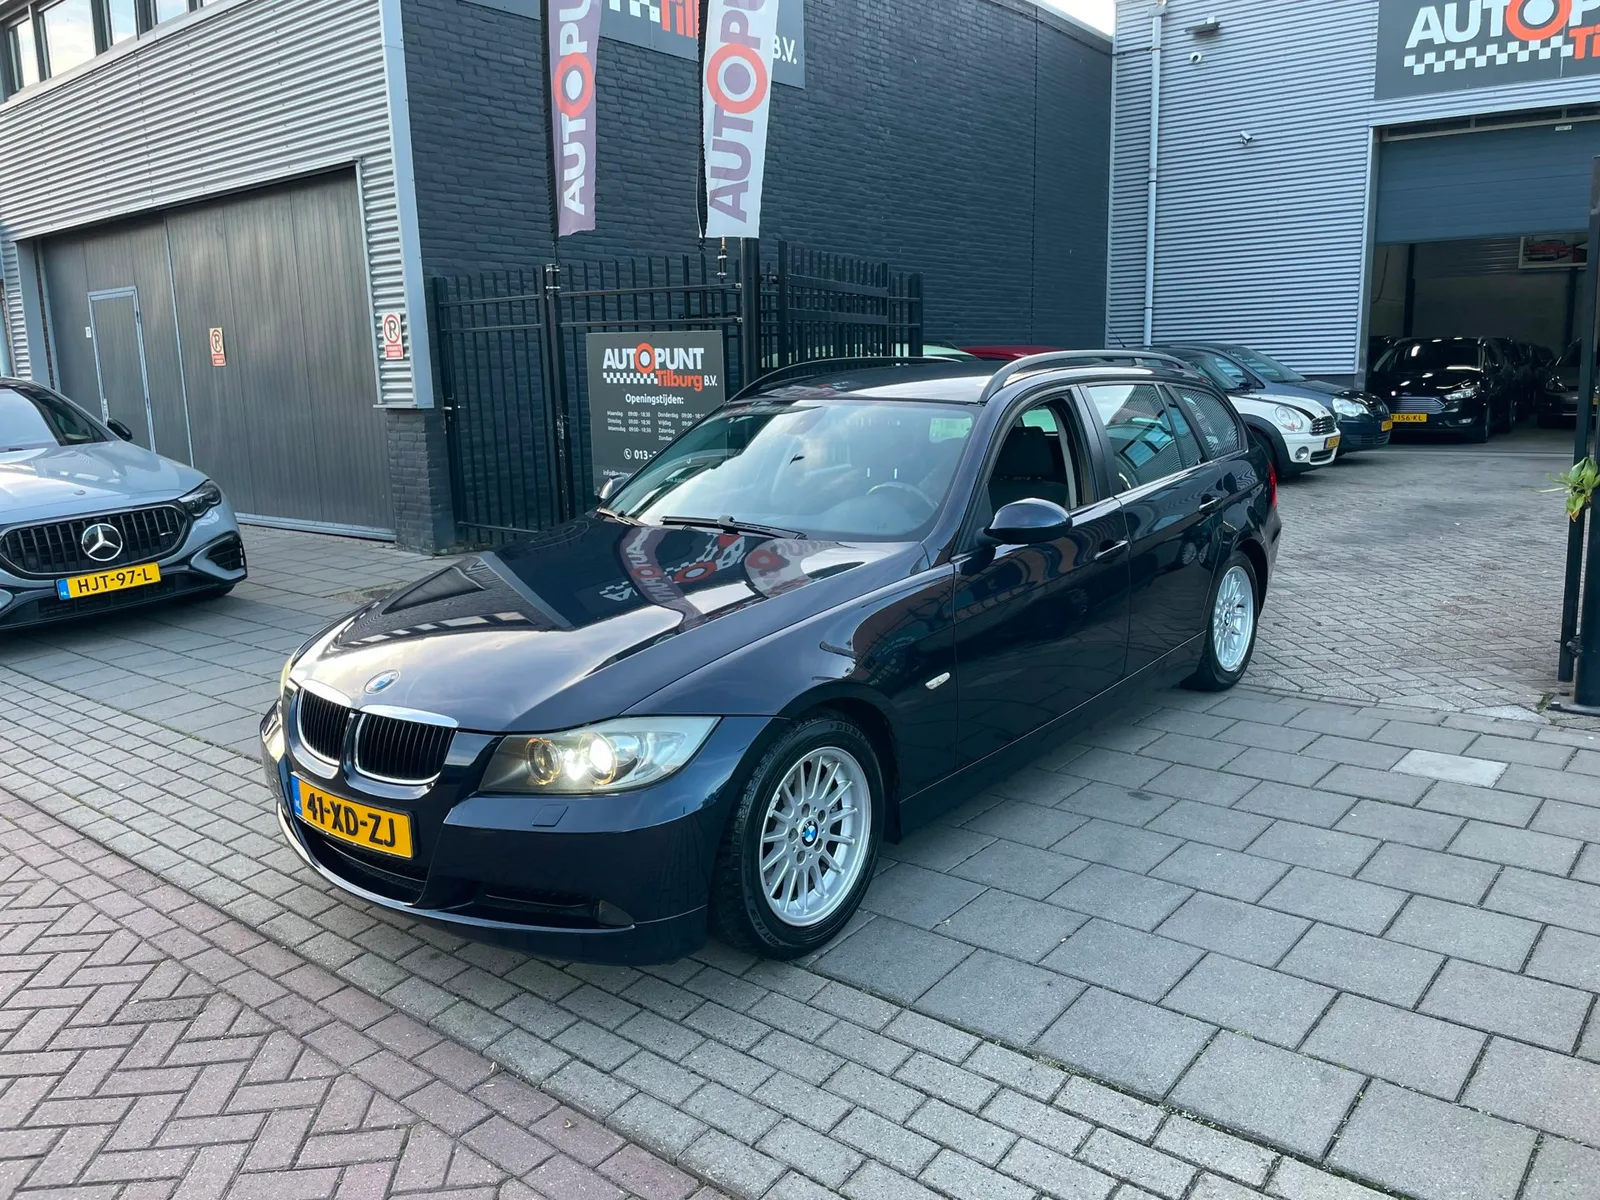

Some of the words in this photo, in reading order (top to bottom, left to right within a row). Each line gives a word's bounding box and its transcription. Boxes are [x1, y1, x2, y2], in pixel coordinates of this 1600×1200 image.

[707, 0, 767, 223] AUTOP
[603, 343, 704, 374] AUTOPUNT
[656, 370, 703, 391] Tilburg
[704, 375, 718, 386] B.V.
[625, 393, 684, 406] Openingstijden:
[634, 449, 657, 460] 013-
[77, 568, 152, 593] HJT-97-L
[307, 792, 396, 848] 41-XD-ZJ
